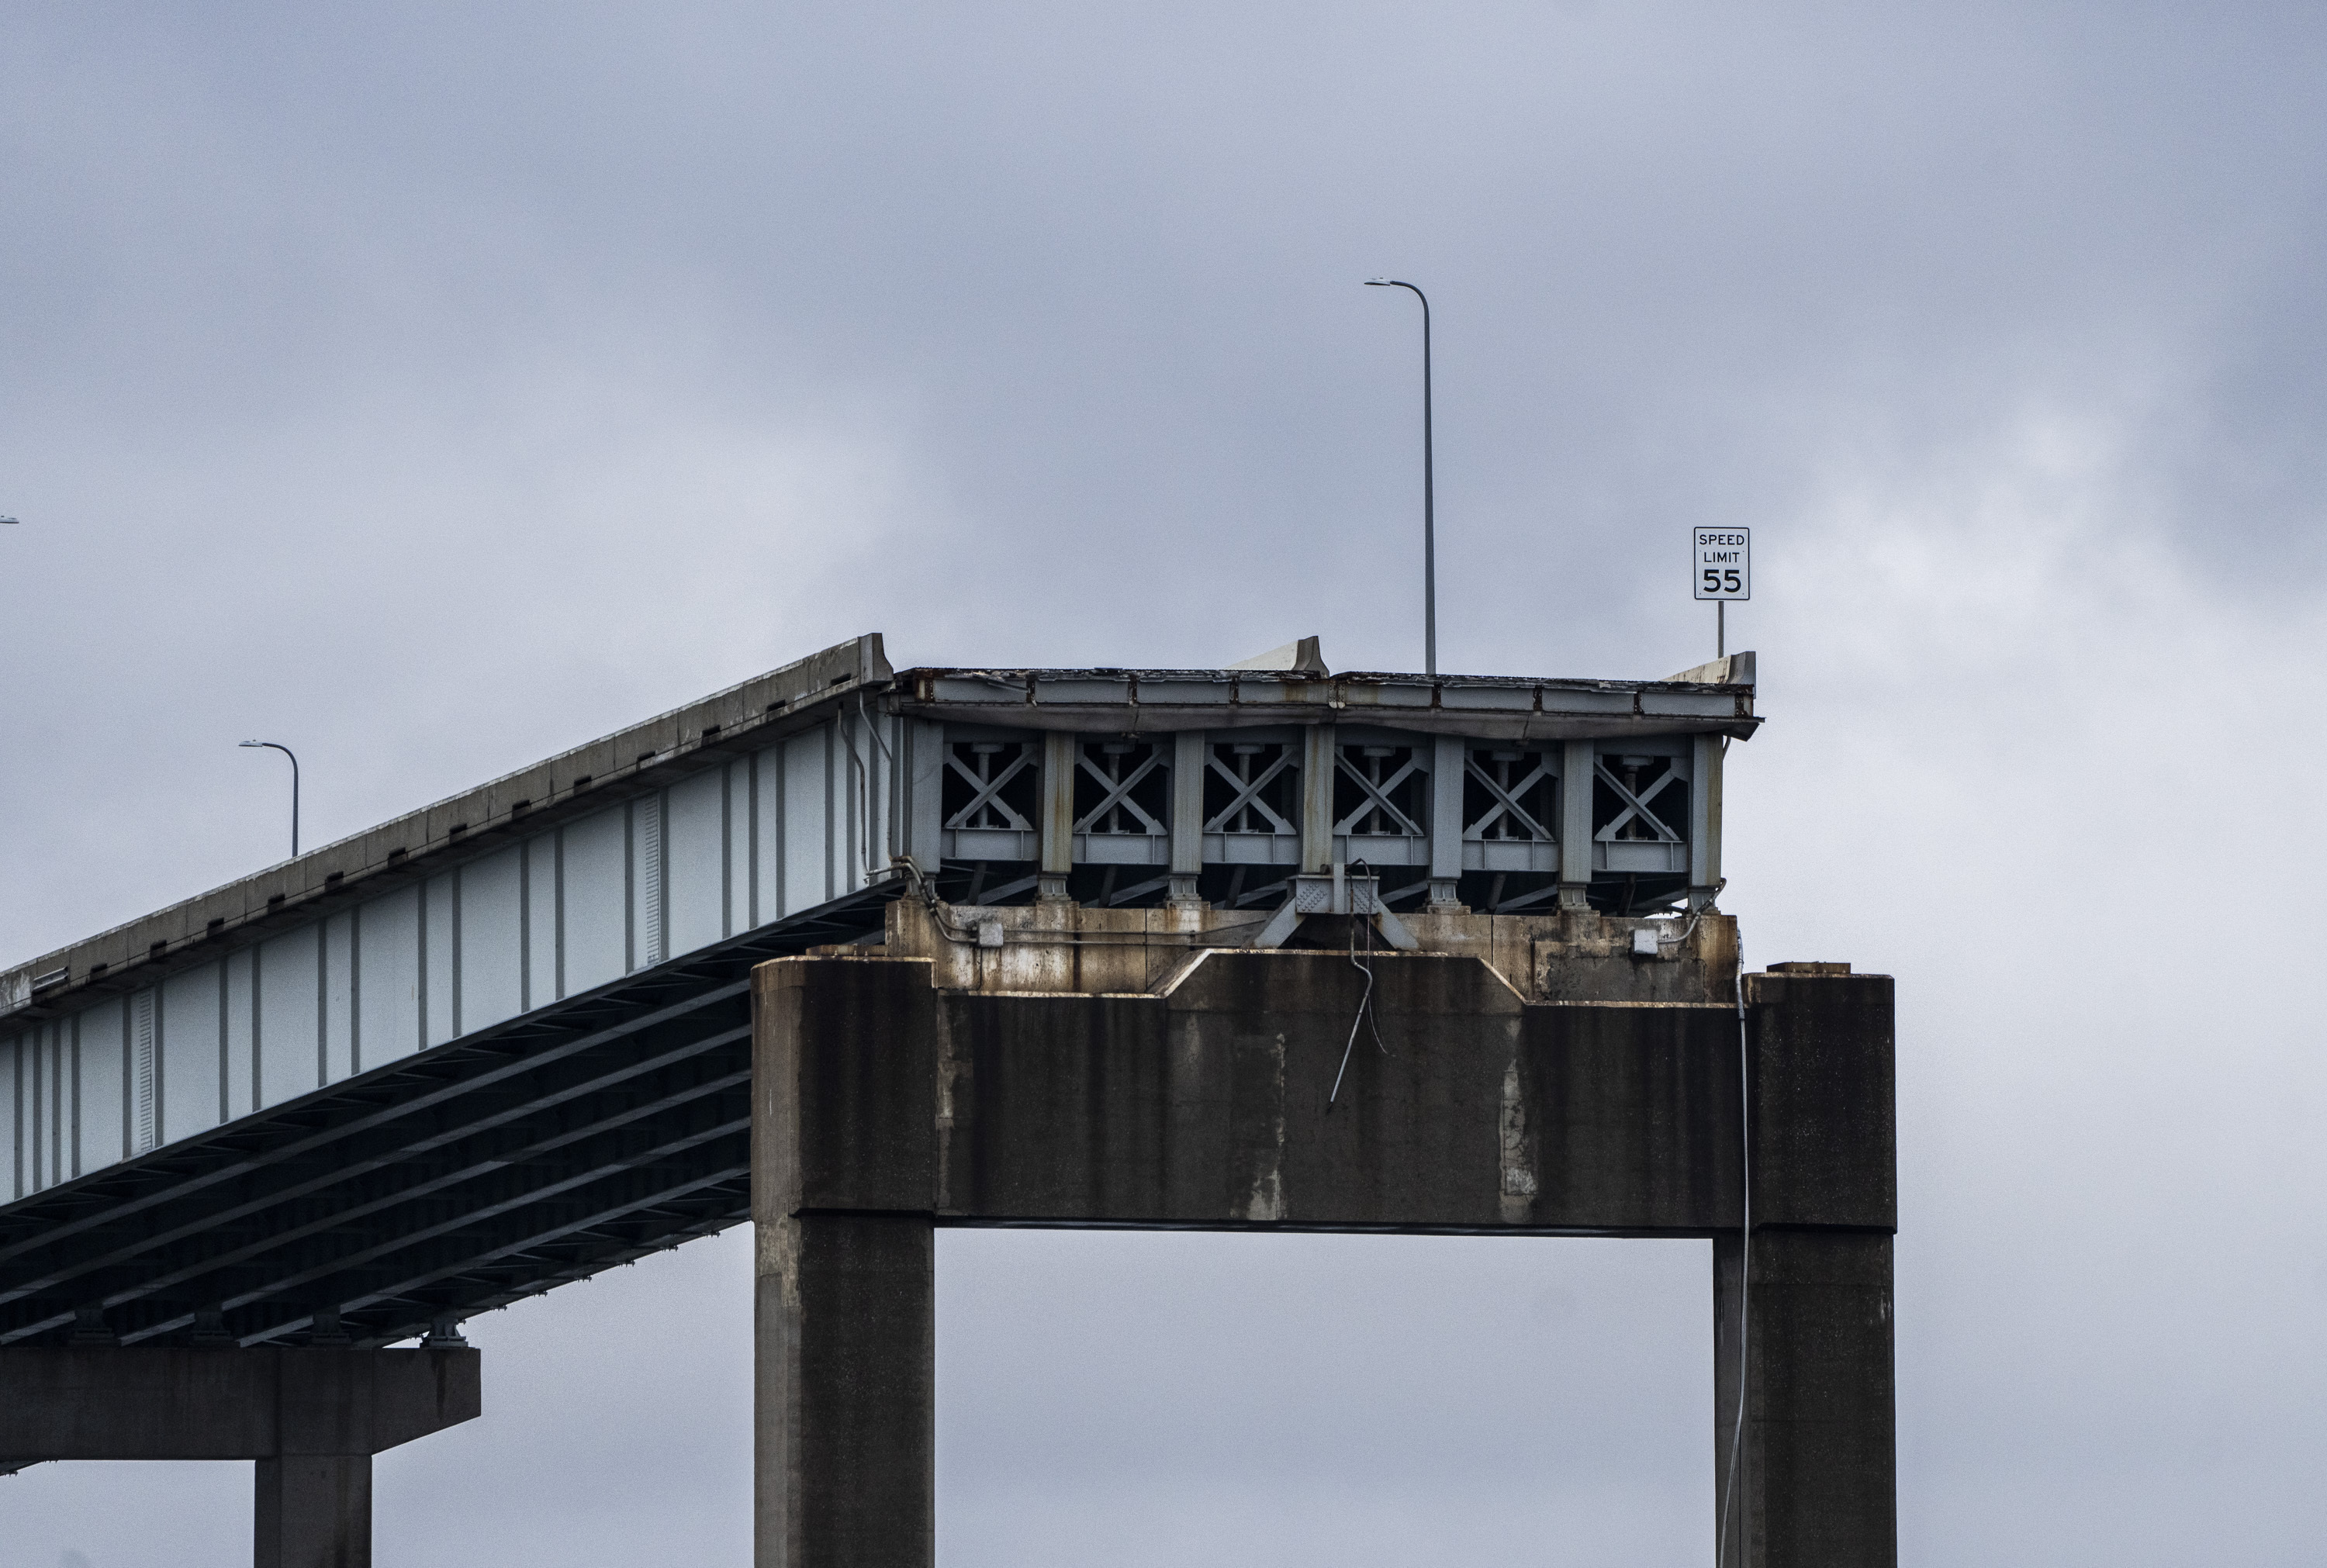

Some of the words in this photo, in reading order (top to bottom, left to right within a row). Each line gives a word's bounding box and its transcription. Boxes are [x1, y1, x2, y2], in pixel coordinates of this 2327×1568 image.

[1699, 534, 1744, 545] SPEED
[1704, 552, 1740, 563] LIMIT
[1703, 569, 1741, 592] 55
